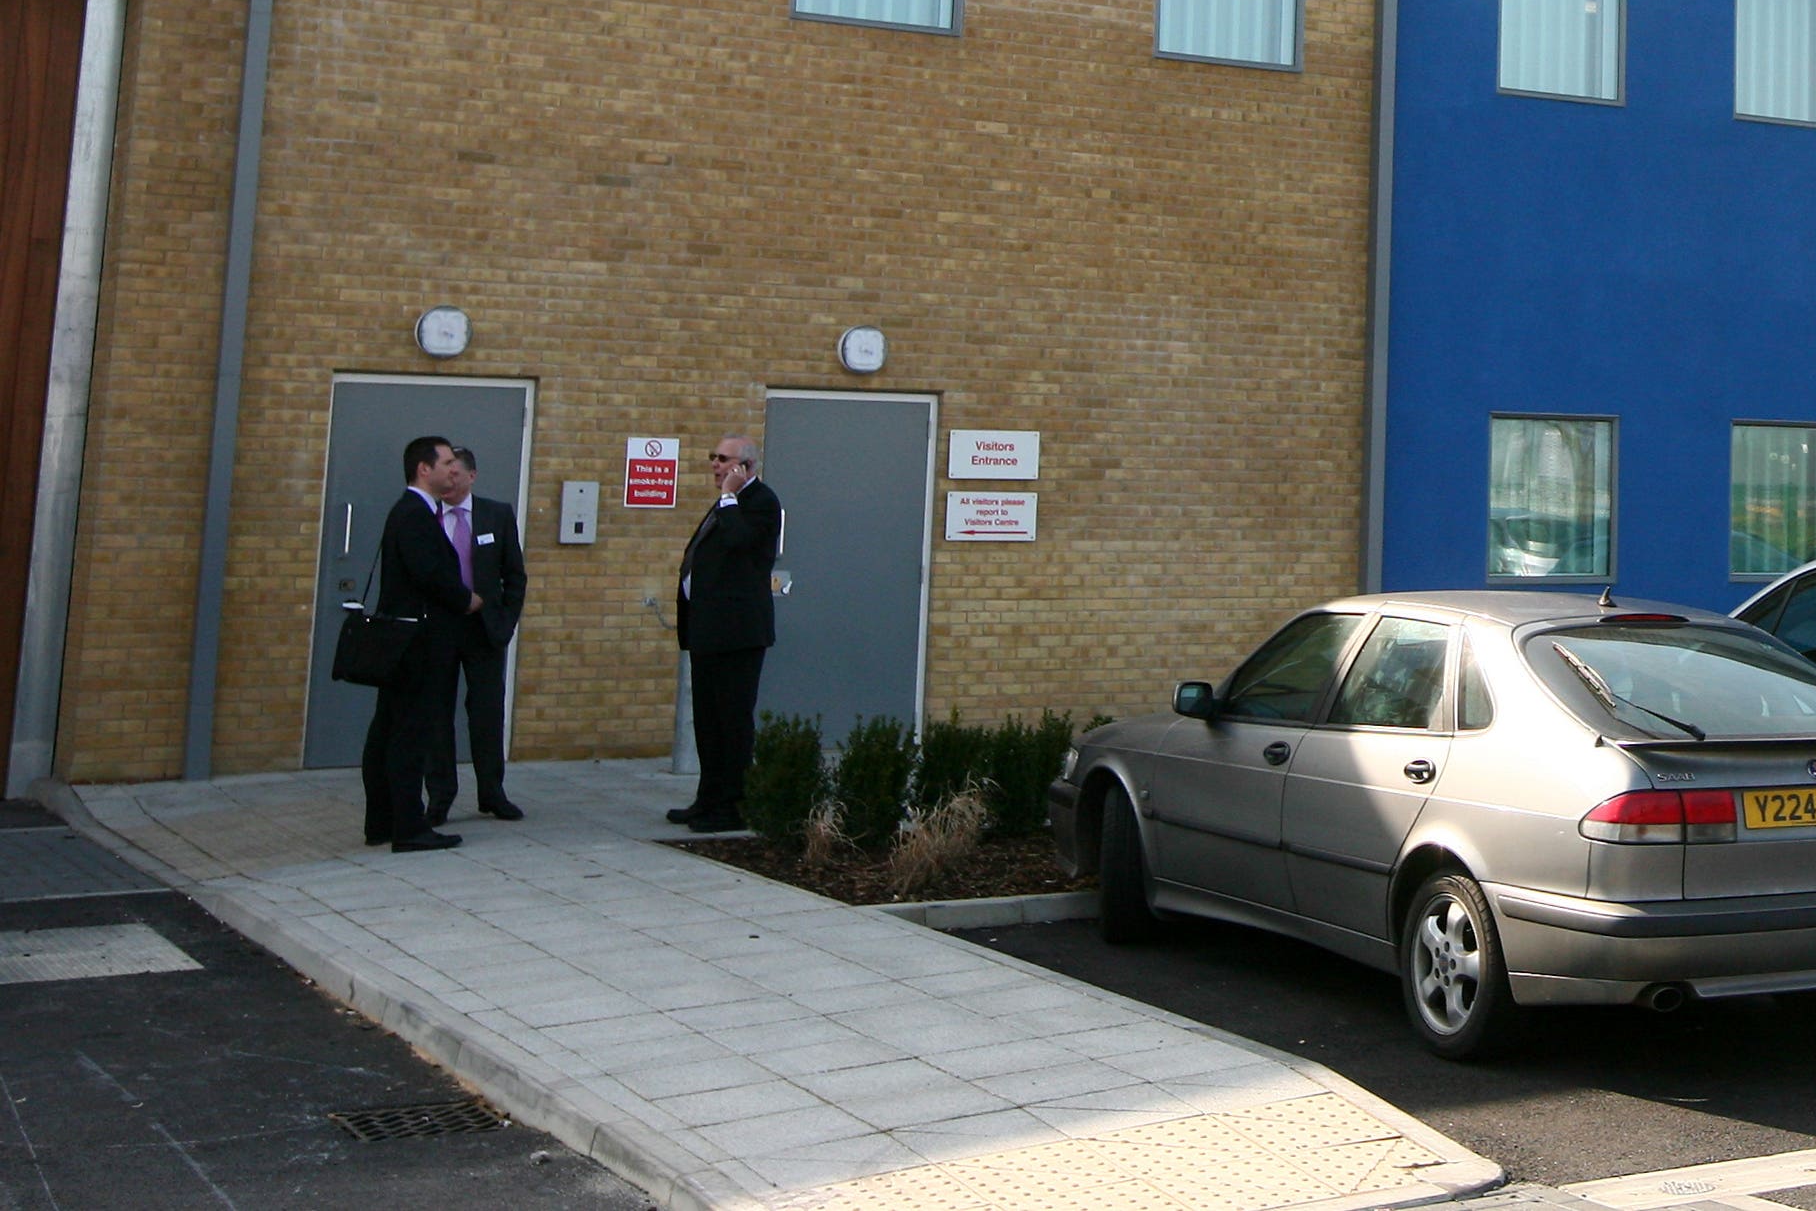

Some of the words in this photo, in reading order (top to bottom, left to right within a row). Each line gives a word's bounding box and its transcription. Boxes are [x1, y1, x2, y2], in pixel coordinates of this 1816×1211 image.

[975, 440, 1015, 451] Visitors
[971, 455, 1018, 466] Entrance
[636, 465, 653, 473] This
[654, 465, 662, 473] is
[629, 478, 674, 486] smoke-free
[634, 490, 667, 499] building
[960, 497, 970, 505] All
[972, 498, 999, 506] visitors
[1000, 498, 1026, 507] please
[976, 508, 999, 517] report
[1000, 508, 1009, 516] to
[964, 518, 992, 526] Visitors
[994, 518, 1019, 526] Centre
[1657, 772, 1696, 782] SAAB
